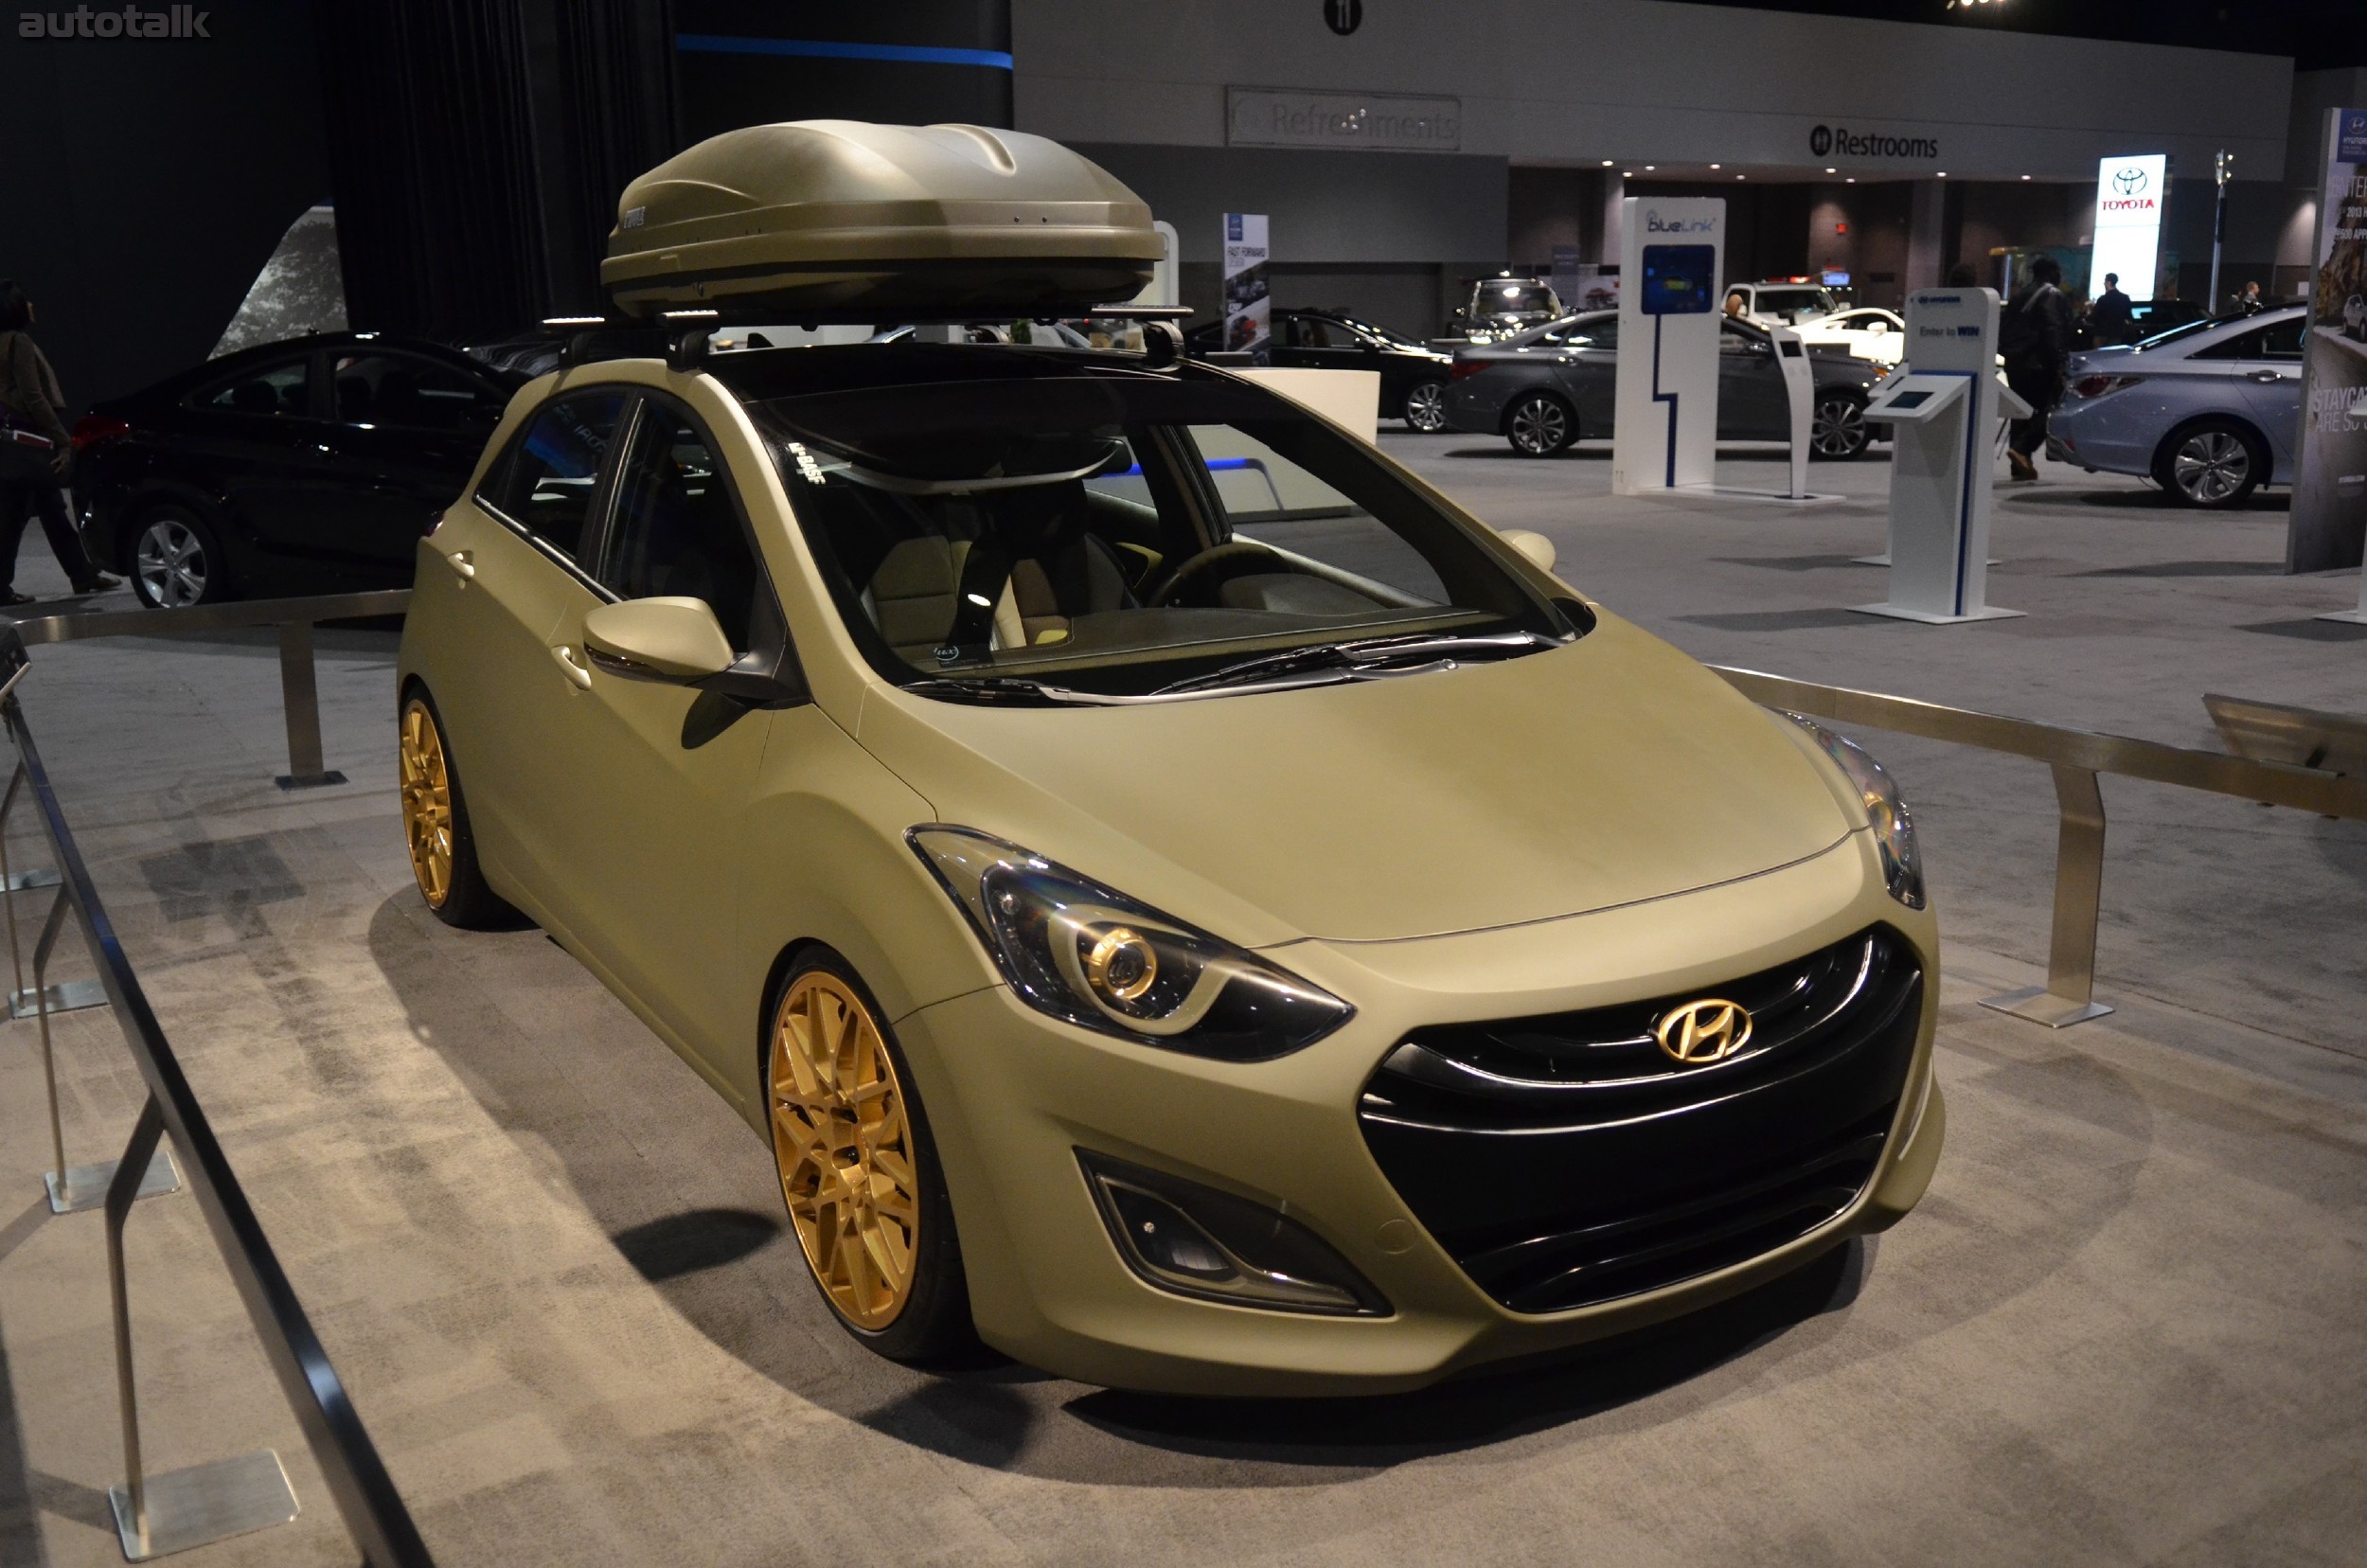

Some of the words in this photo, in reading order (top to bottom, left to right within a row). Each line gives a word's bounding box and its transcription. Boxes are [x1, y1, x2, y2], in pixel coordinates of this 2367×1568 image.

[1272, 103, 1456, 140] Refreshments
[1836, 128, 1938, 159] Restrooms
[2102, 199, 2155, 211] TOYOTA
[1920, 326, 1944, 337] Enter
[1947, 326, 1956, 337] to
[1957, 326, 1981, 337] WIN
[2315, 411, 2340, 433] ARE
